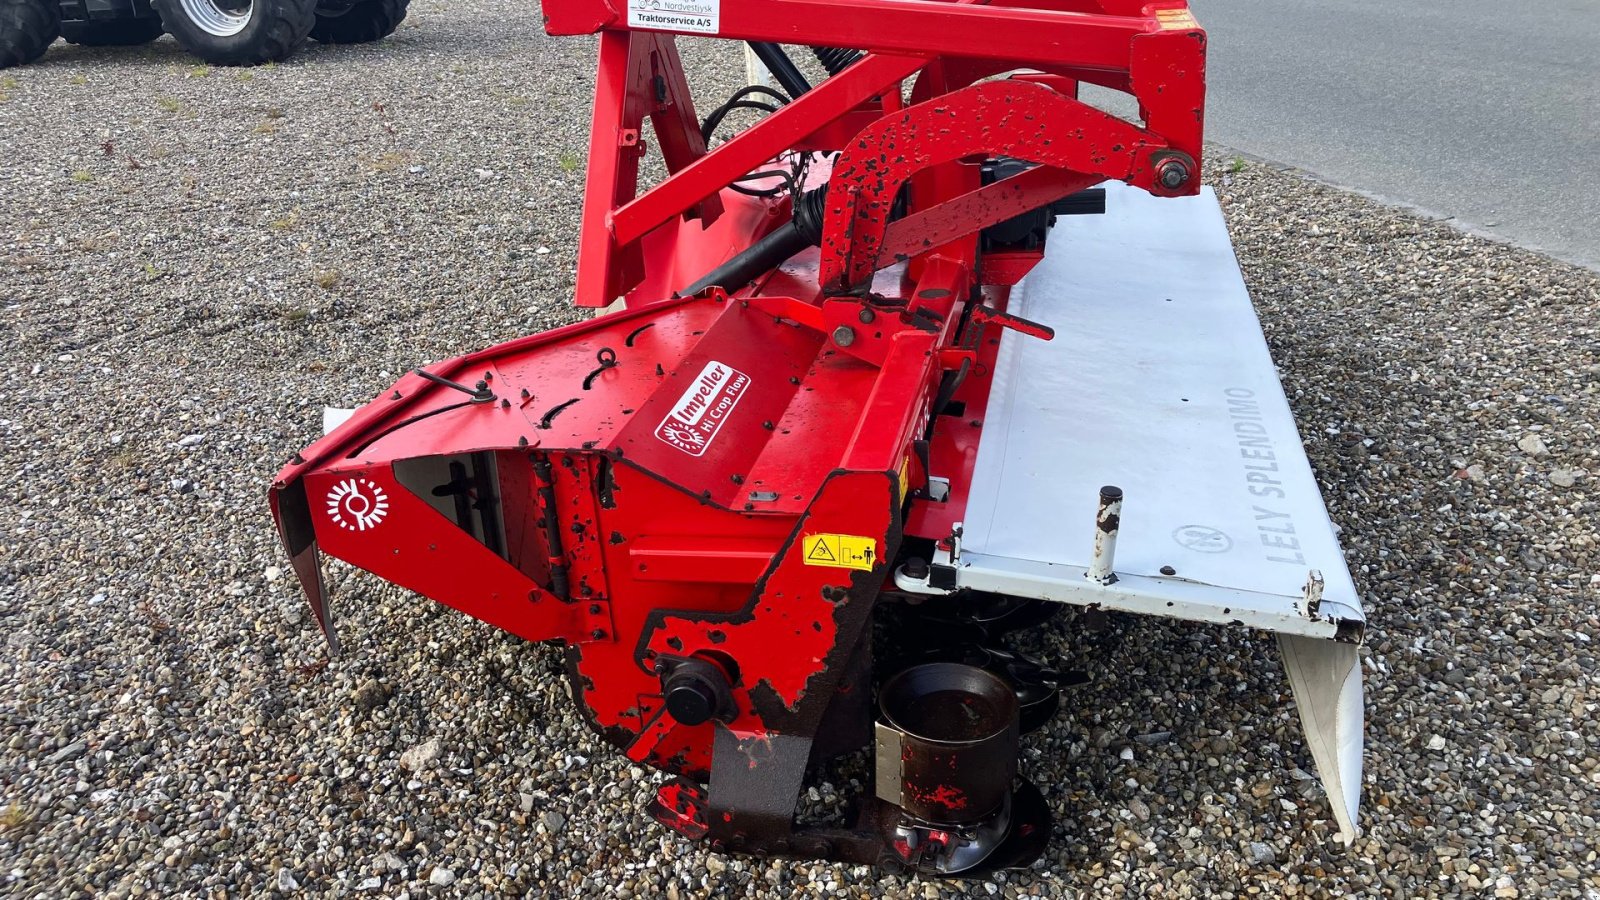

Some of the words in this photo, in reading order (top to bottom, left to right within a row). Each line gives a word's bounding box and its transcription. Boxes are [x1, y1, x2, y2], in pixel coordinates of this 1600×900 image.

[638, 13, 695, 25] Traktorservice
[697, 18, 712, 27] A/S
[664, 2, 713, 13] Nordvestjysk
[677, 365, 725, 421] Impeller
[700, 418, 715, 432] Hi
[710, 396, 732, 419] Crop
[725, 374, 746, 396] Flow
[1223, 387, 1286, 499] SPLENDIMO
[1252, 505, 1306, 566] LELY
